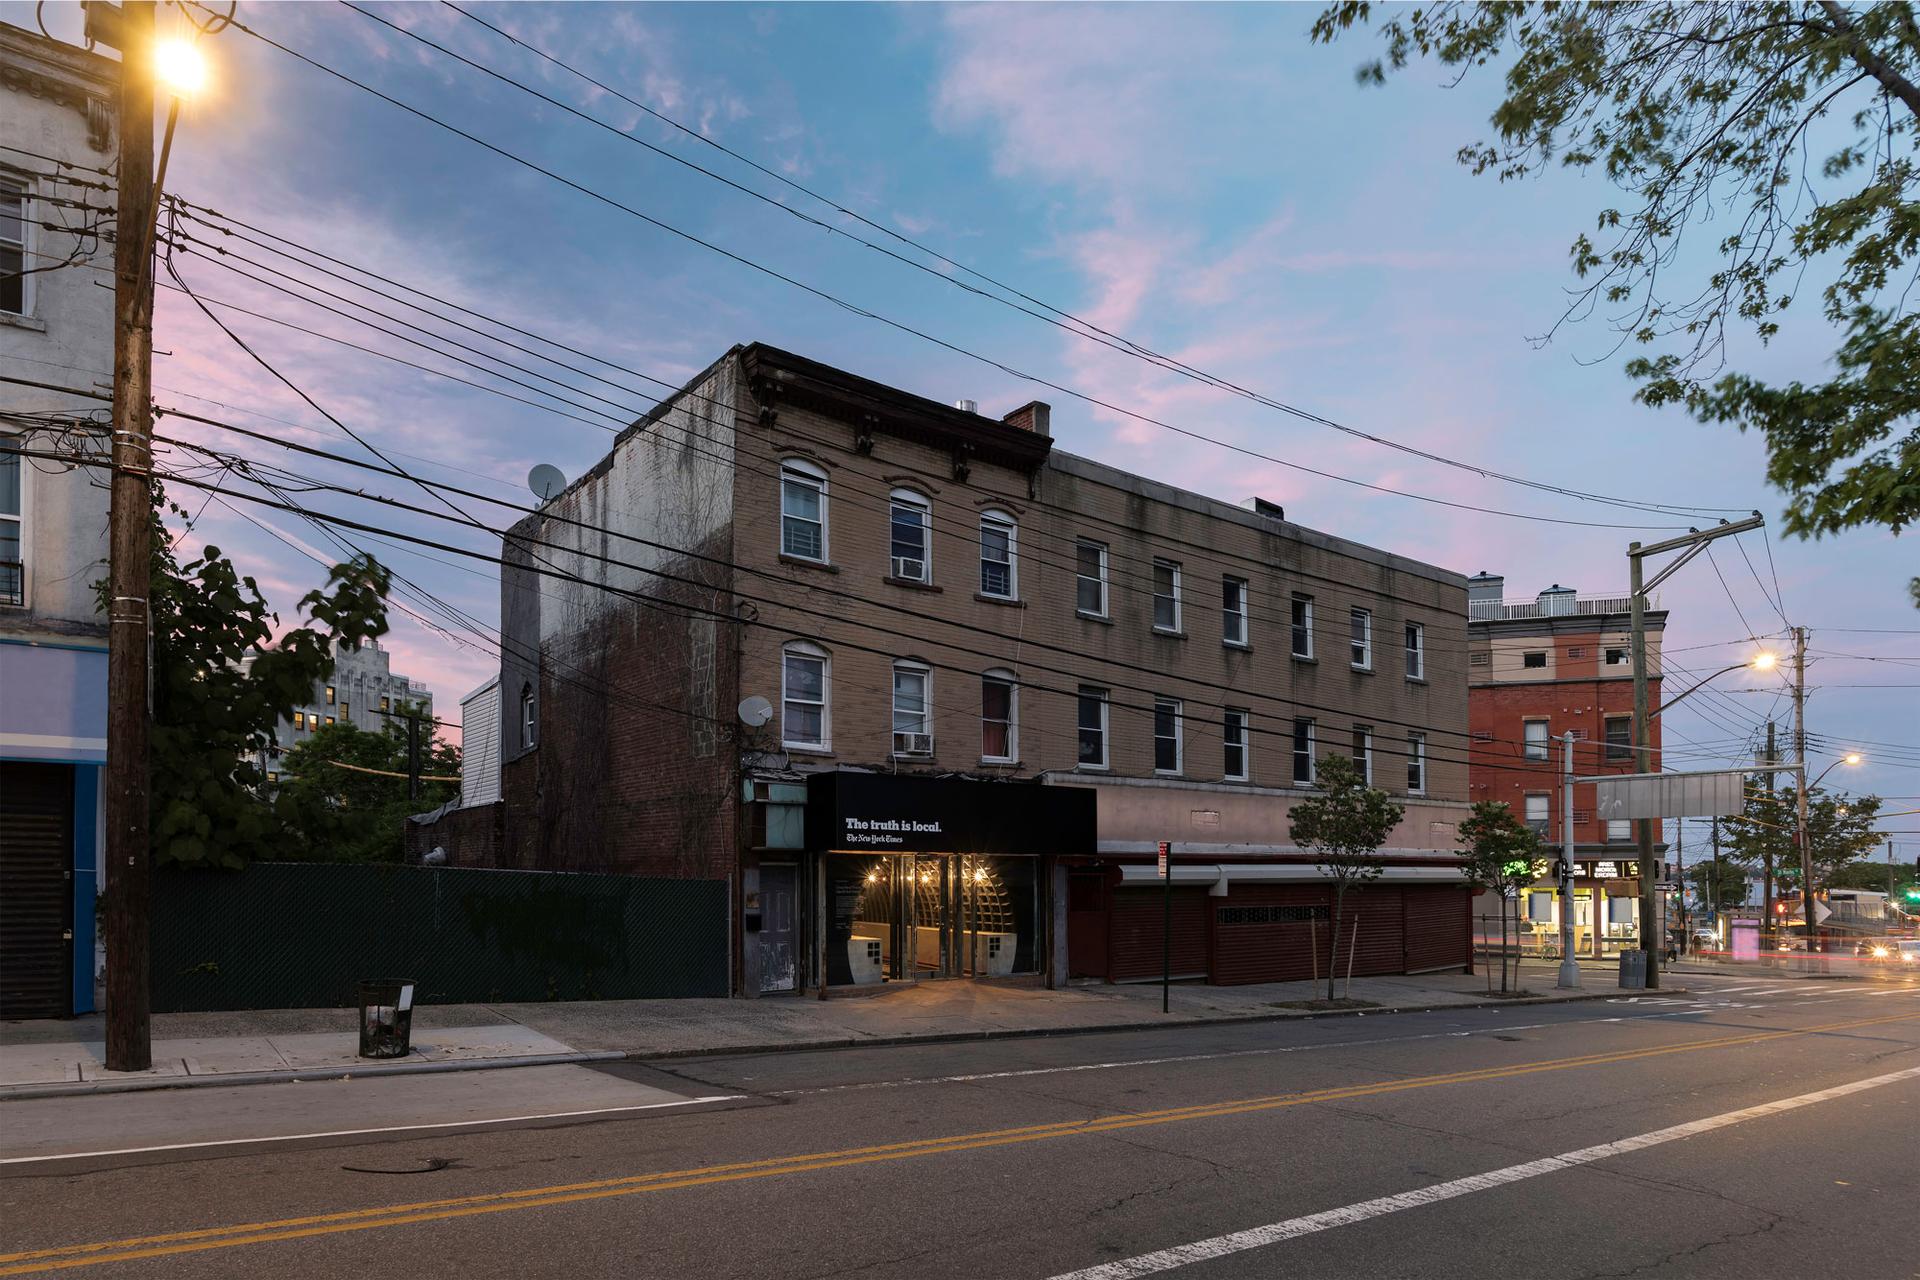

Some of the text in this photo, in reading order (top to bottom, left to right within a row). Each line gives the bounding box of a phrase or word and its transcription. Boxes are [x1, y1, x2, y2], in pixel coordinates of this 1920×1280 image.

[846, 818, 942, 832] The truth is local.
[846, 833, 903, 845] The New York Times
